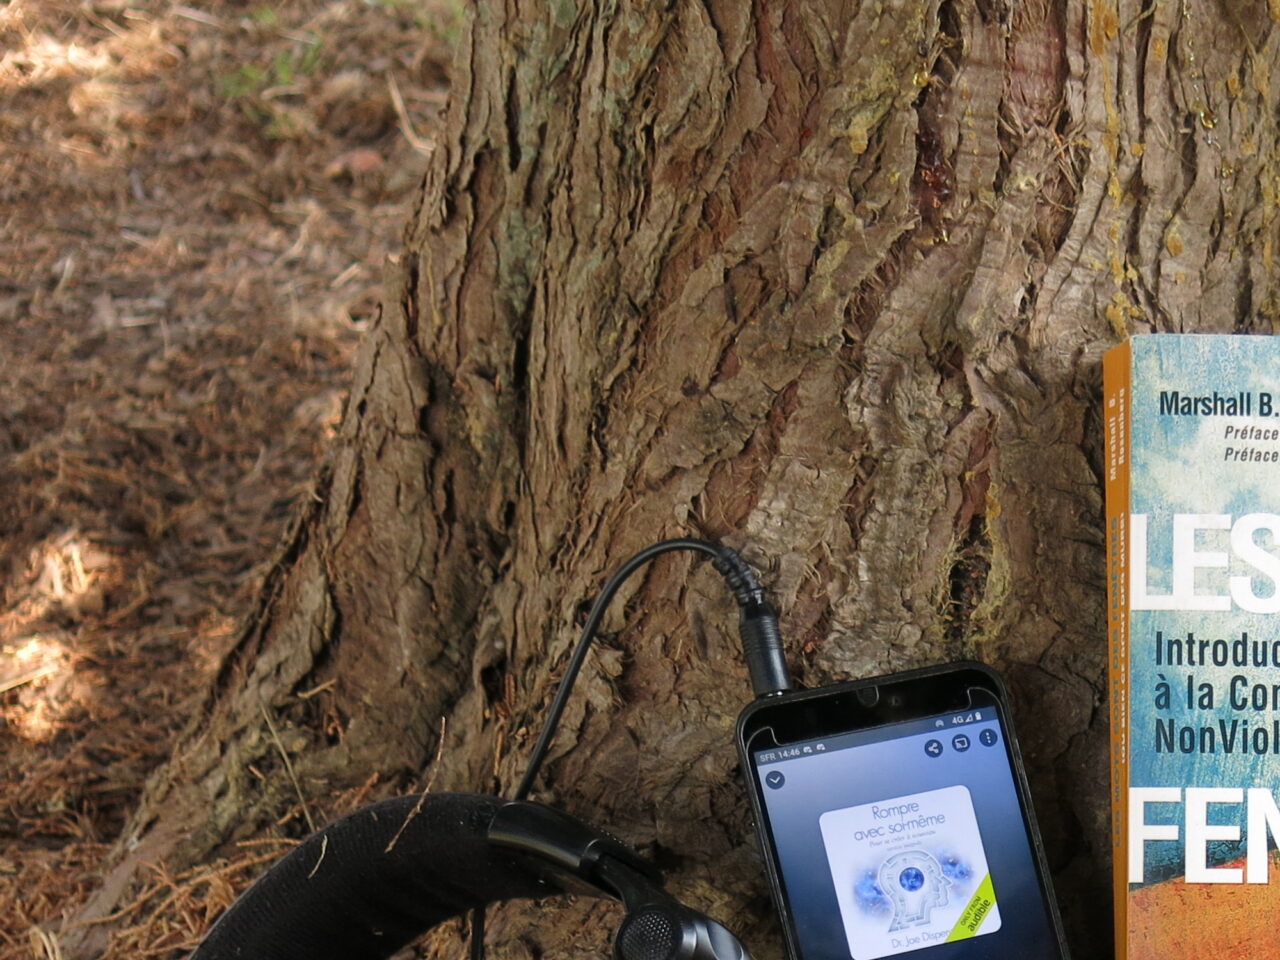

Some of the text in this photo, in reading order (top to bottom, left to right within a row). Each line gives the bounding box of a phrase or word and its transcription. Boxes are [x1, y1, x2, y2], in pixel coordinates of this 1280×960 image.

[1159, 391, 1251, 417] Marshall
[1259, 394, 1279, 419] B.
[1224, 424, 1279, 442] Préface
[1224, 446, 1279, 464] Préface
[1154, 673, 1169, 711] à
[1187, 676, 1214, 711] la
[952, 715, 963, 725] 4G
[759, 747, 800, 763] SFR 14:46
[872, 801, 919, 823] Rompre
[854, 826, 885, 841] avec
[888, 813, 946, 834] soi-même
[968, 899, 991, 931] audible
[906, 935, 921, 947] Joe
